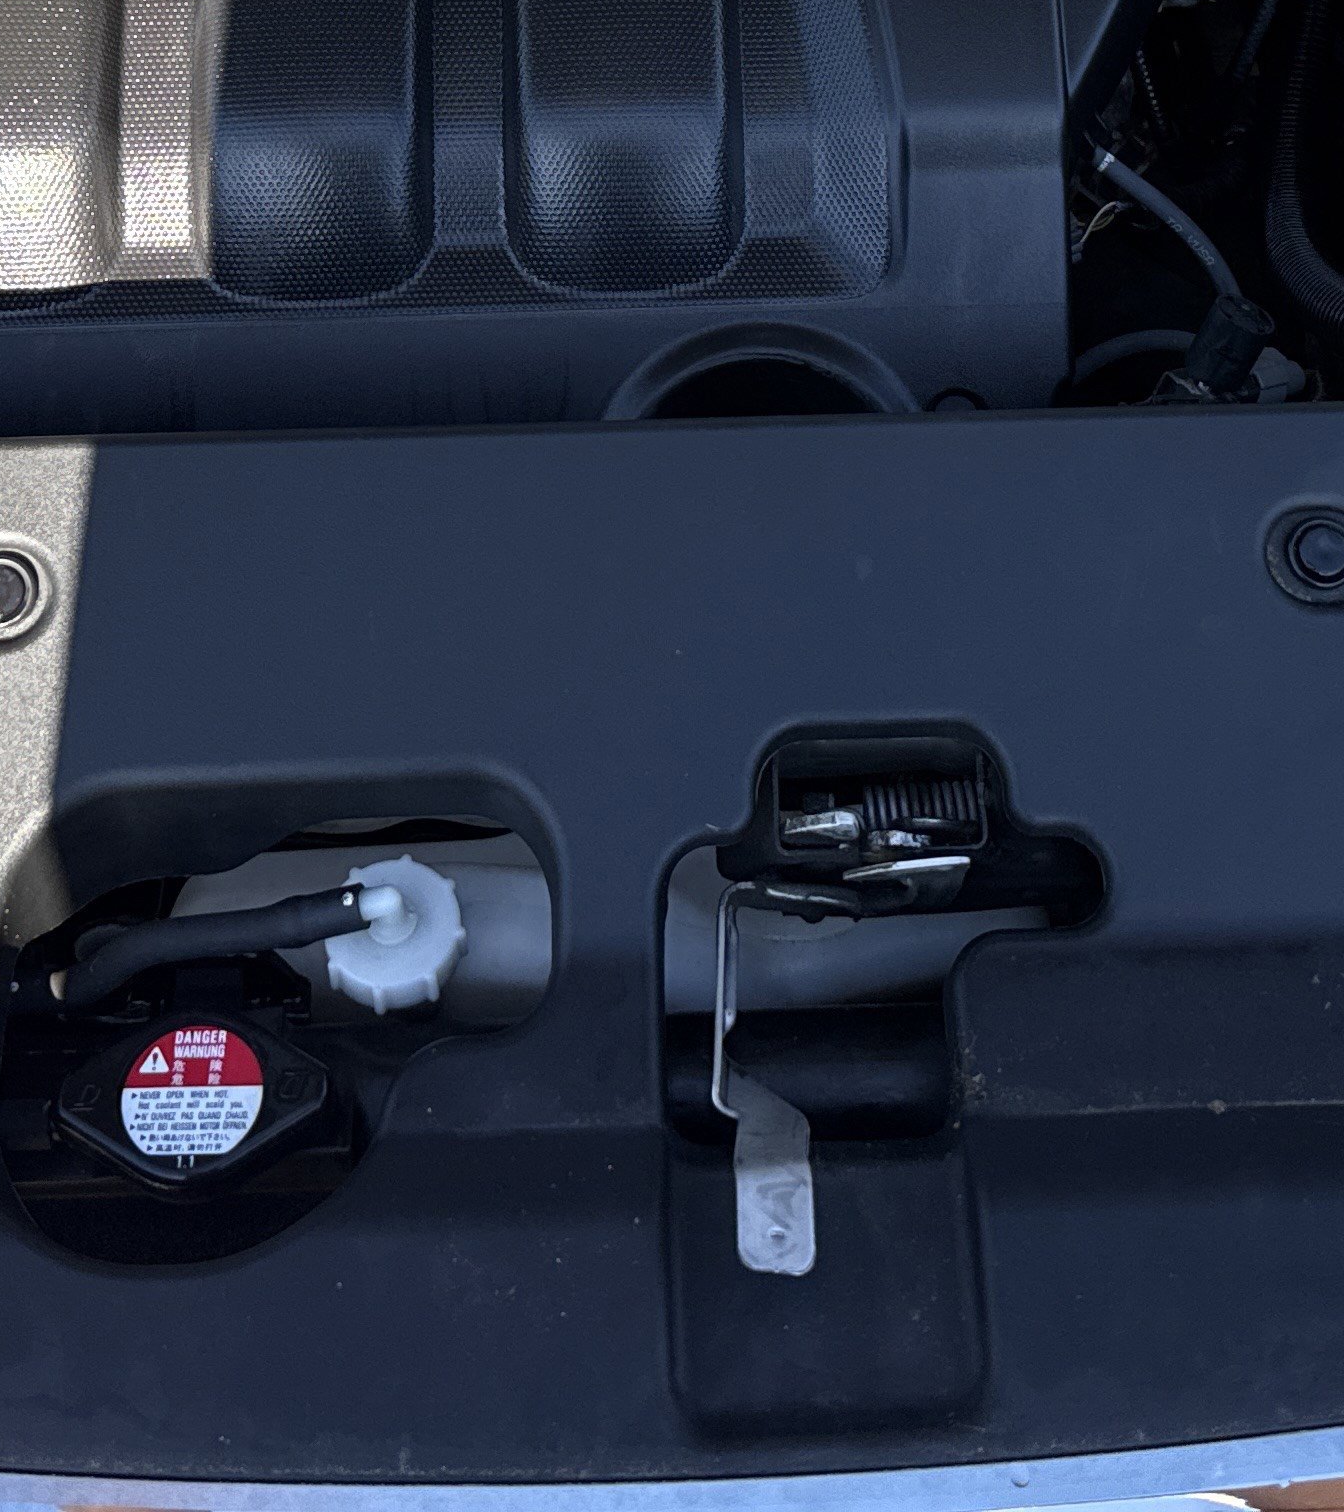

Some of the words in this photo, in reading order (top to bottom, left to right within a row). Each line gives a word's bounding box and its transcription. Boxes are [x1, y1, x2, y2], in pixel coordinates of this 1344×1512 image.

[175, 1030, 227, 1044] DANGER
[174, 1044, 225, 1059] WARNUNG
[139, 1090, 161, 1099] NEVER
[166, 1090, 184, 1099] OPEN
[190, 1090, 209, 1098] WHEN
[181, 1111, 194, 1120] PAS
[177, 1154, 195, 1169] 1.1
